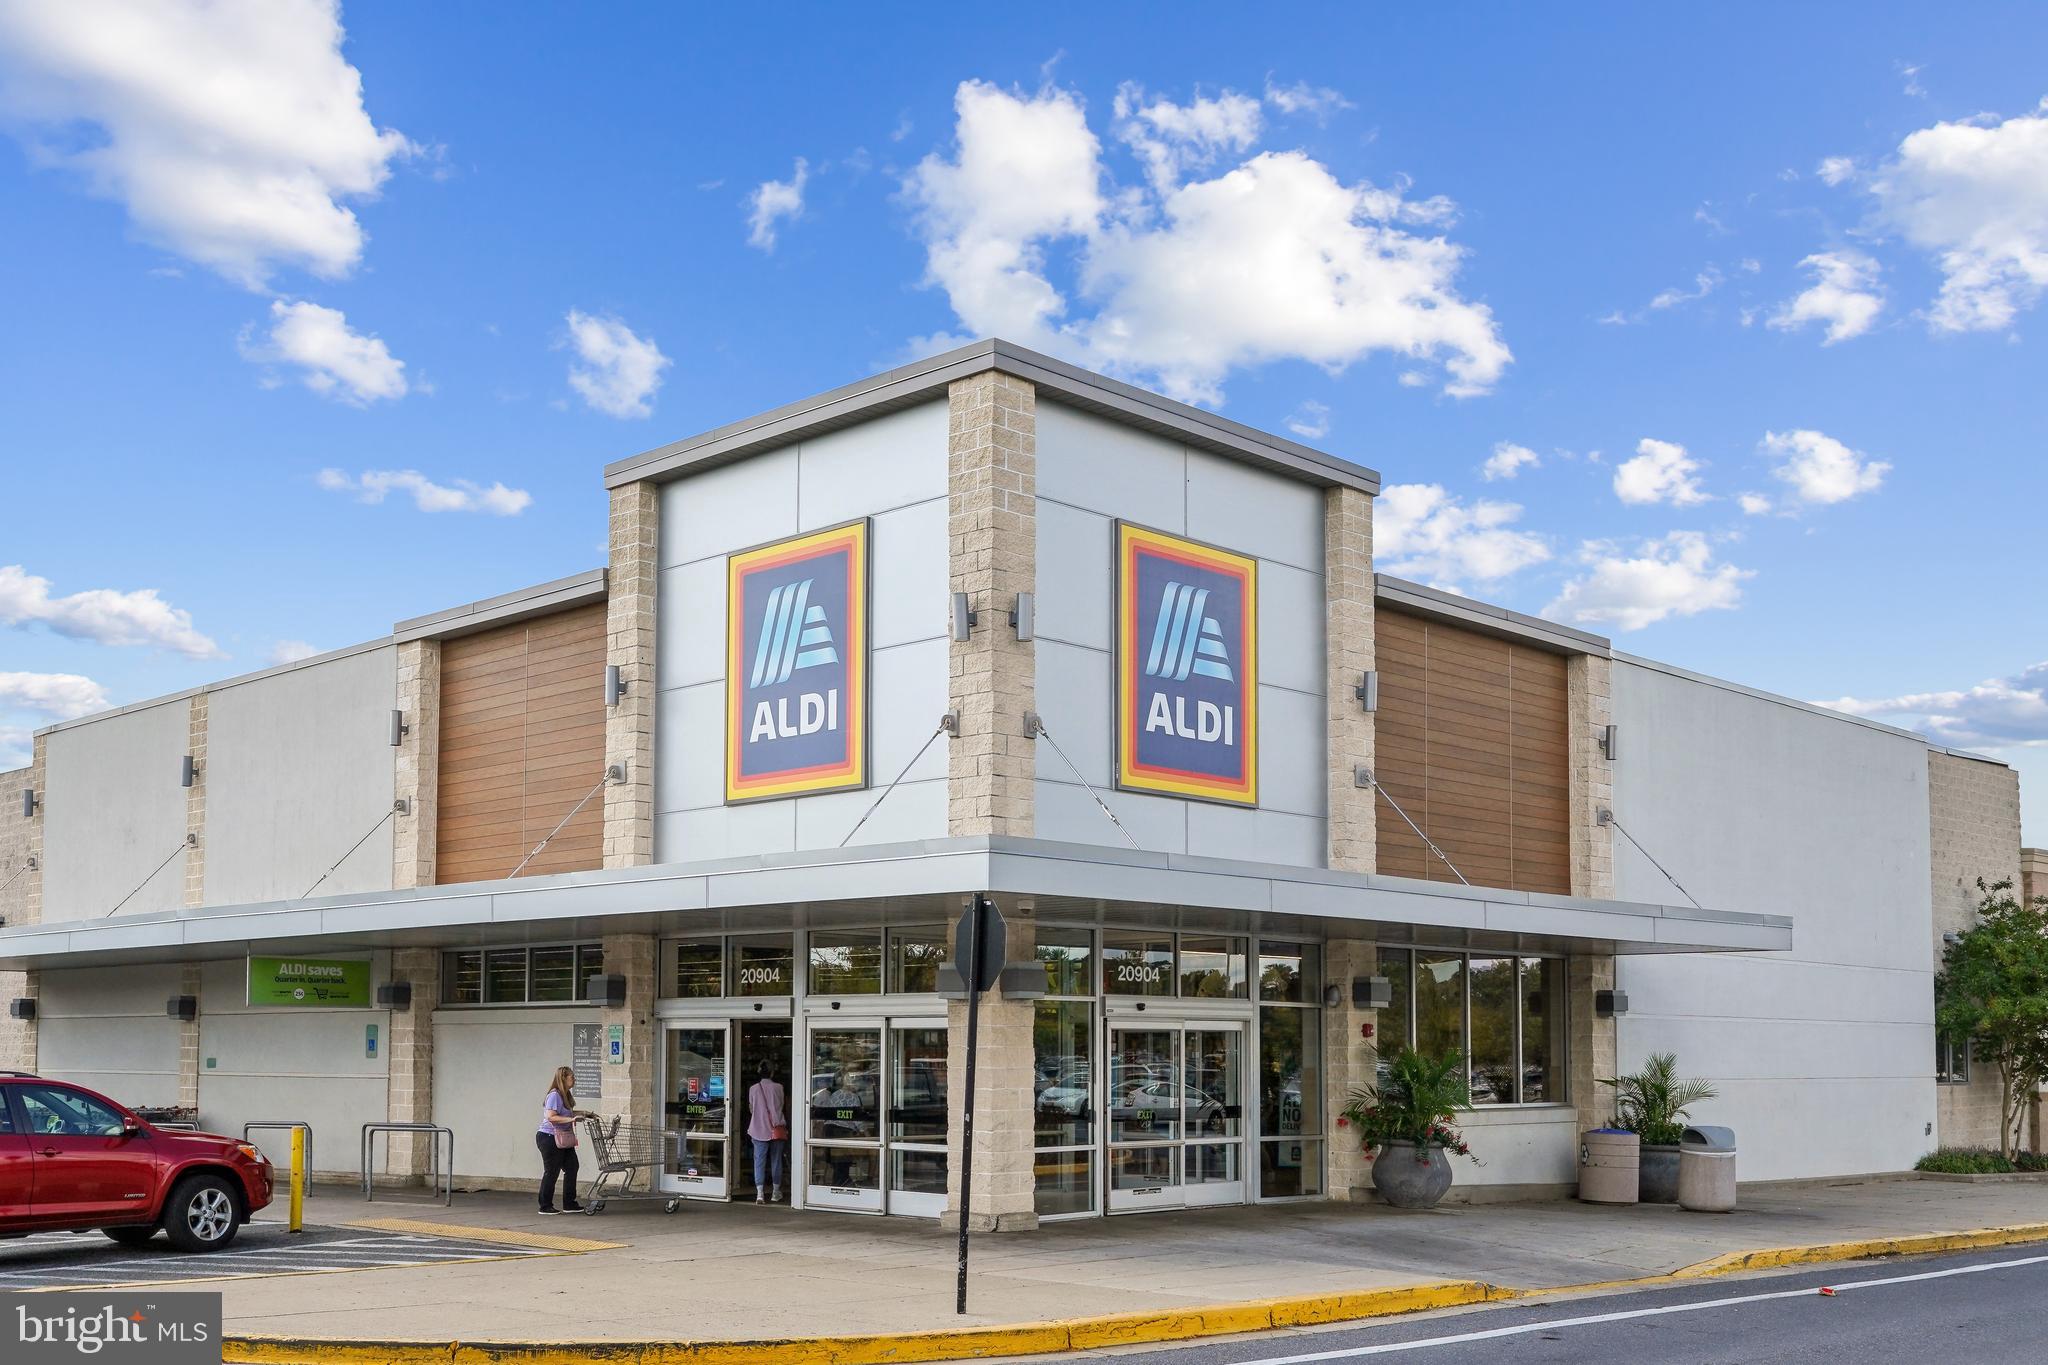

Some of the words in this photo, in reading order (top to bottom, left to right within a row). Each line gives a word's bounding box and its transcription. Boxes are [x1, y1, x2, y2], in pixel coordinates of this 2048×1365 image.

[749, 688, 838, 743] ALDI
[1145, 692, 1233, 746] ALDI
[279, 963, 306, 975] ALDI
[307, 966, 343, 976] saves
[740, 967, 780, 983] 20904
[1117, 965, 1160, 982] 20904
[274, 976, 298, 984] Quarter
[307, 976, 330, 984] Quarter
[1282, 1093, 1302, 1107] AL
[686, 1105, 707, 1113] ENTER
[836, 1110, 853, 1119] EXIT
[1136, 1110, 1153, 1120] EXIT
